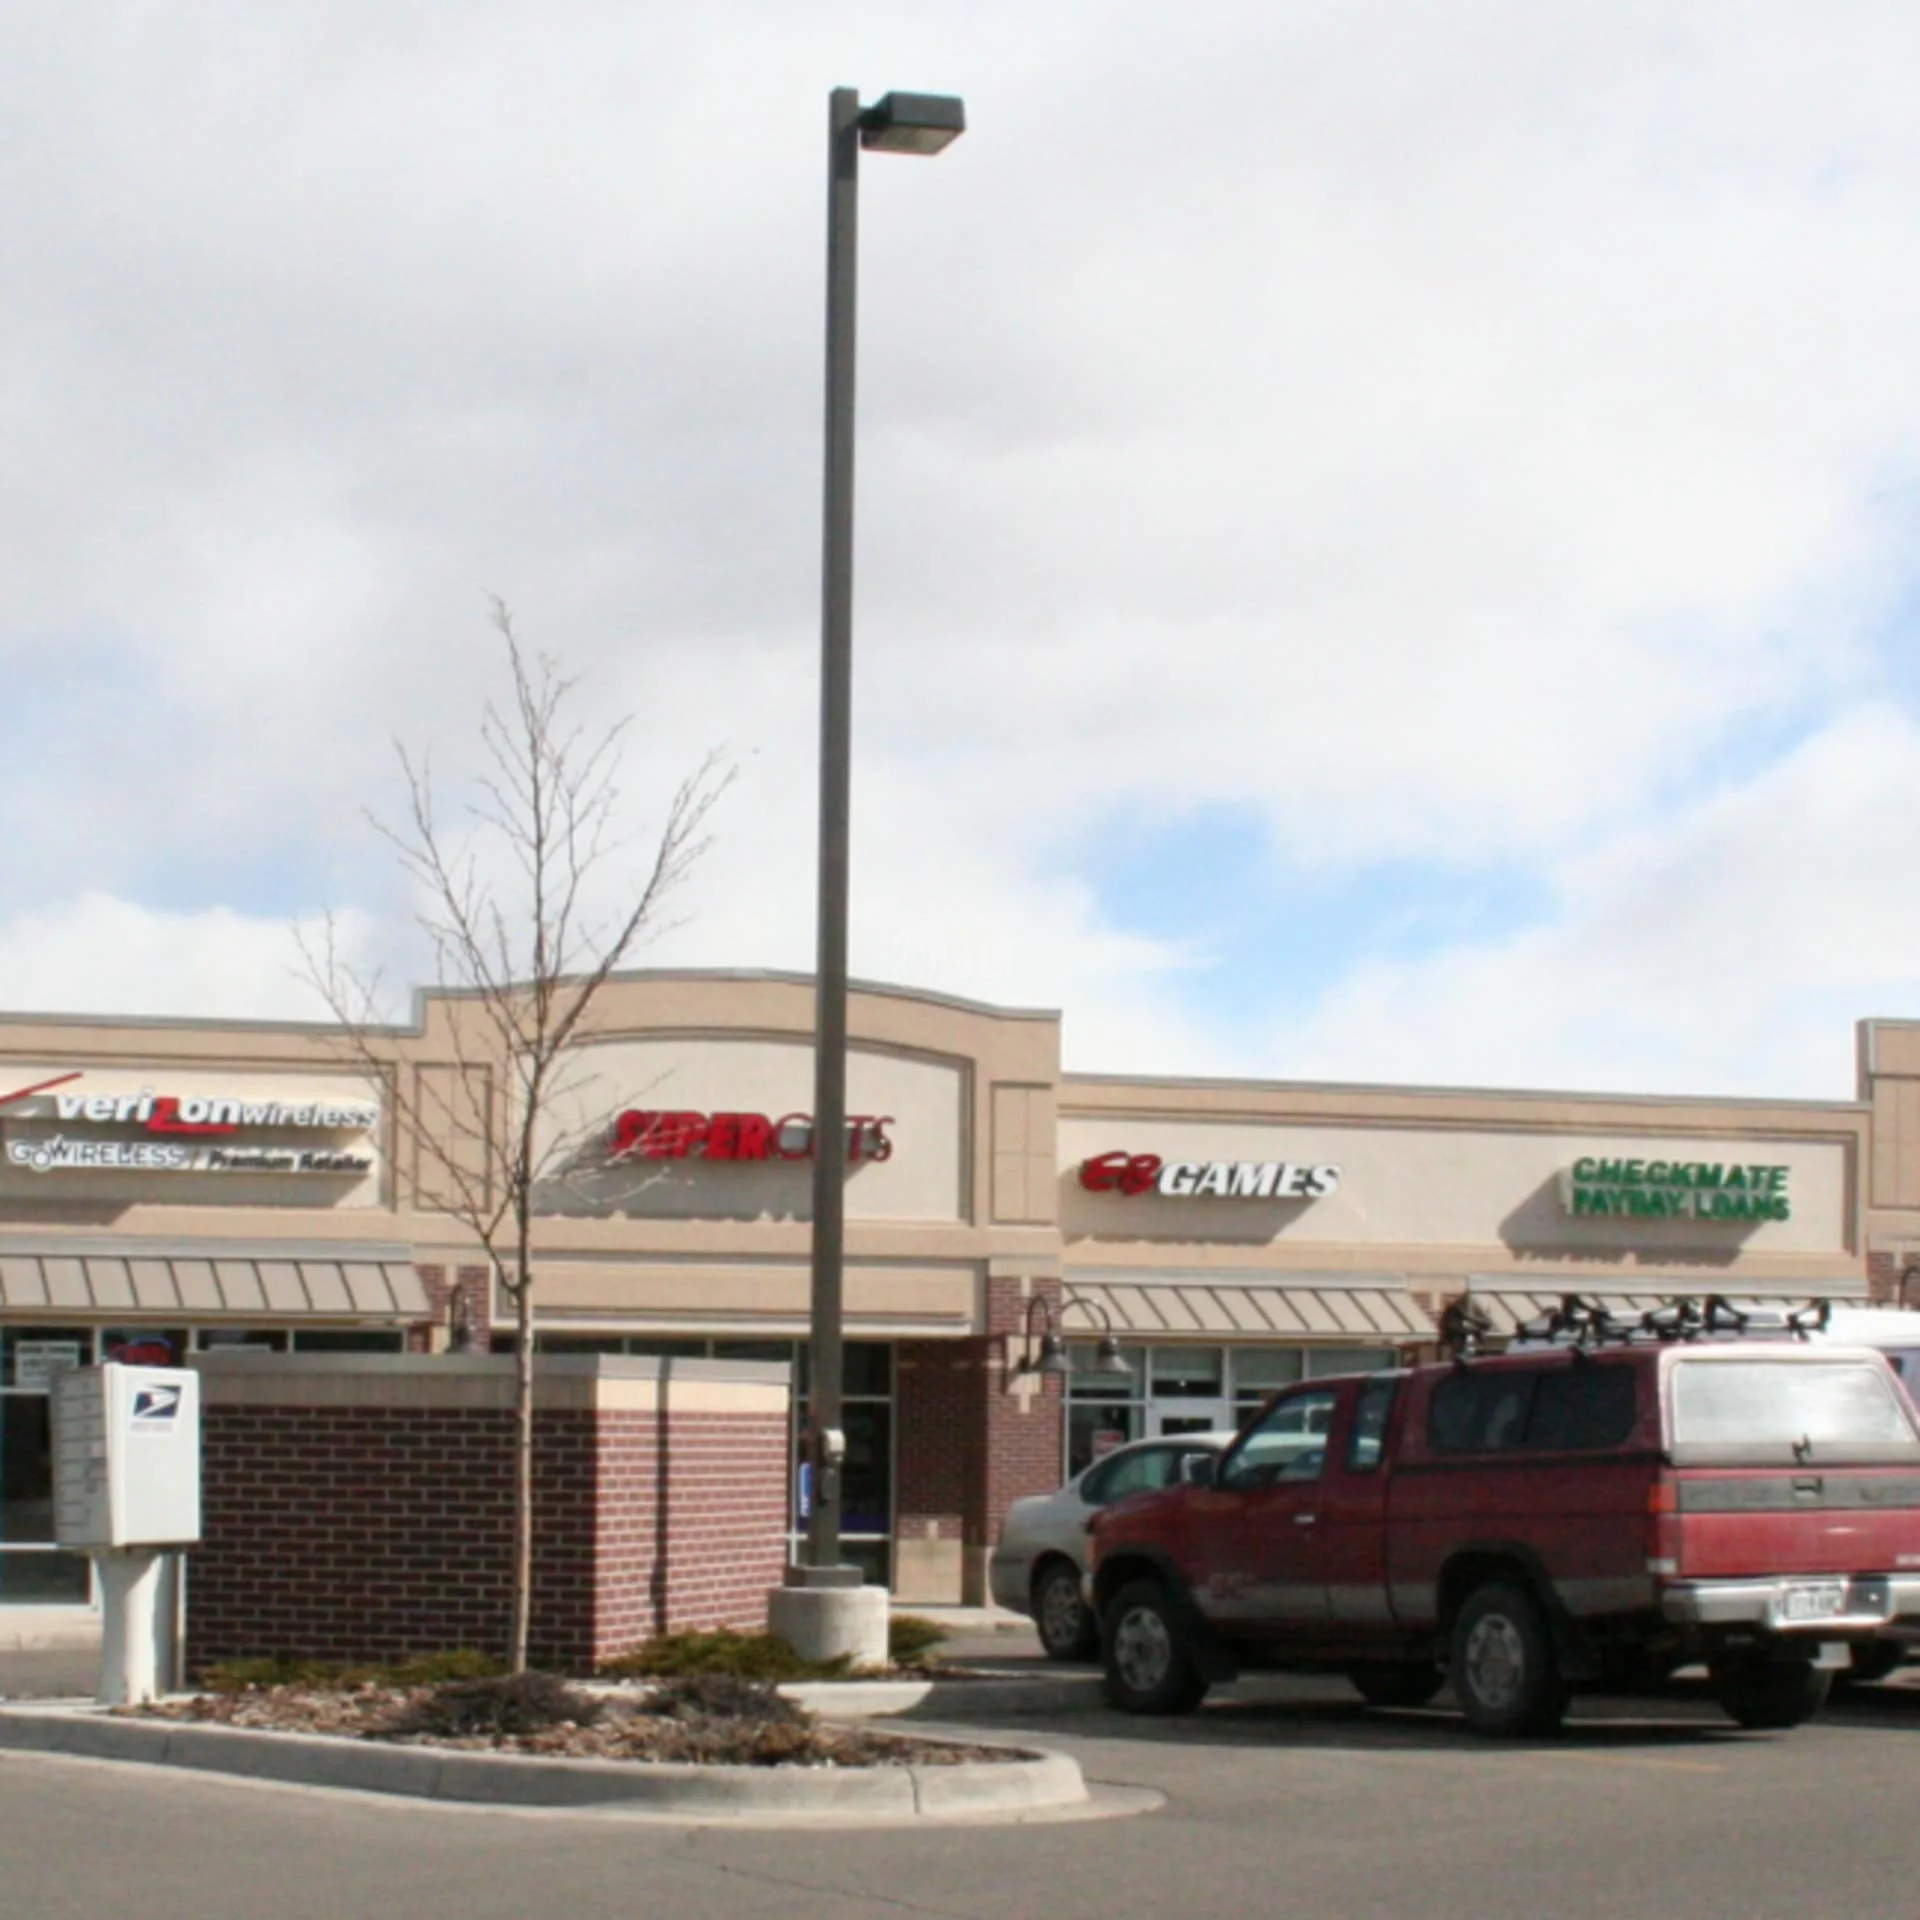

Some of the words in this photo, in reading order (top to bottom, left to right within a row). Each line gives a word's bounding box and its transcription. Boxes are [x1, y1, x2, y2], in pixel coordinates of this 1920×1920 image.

[610, 1109, 896, 1162] SUPERCTS
[1079, 1150, 1162, 1197] EB
[1157, 1161, 1342, 1197] GAMES
[1571, 1156, 1791, 1191] CHECKMATE
[1571, 1186, 1685, 1219] PAYDAY
[1694, 1191, 1791, 1222] LOANS
